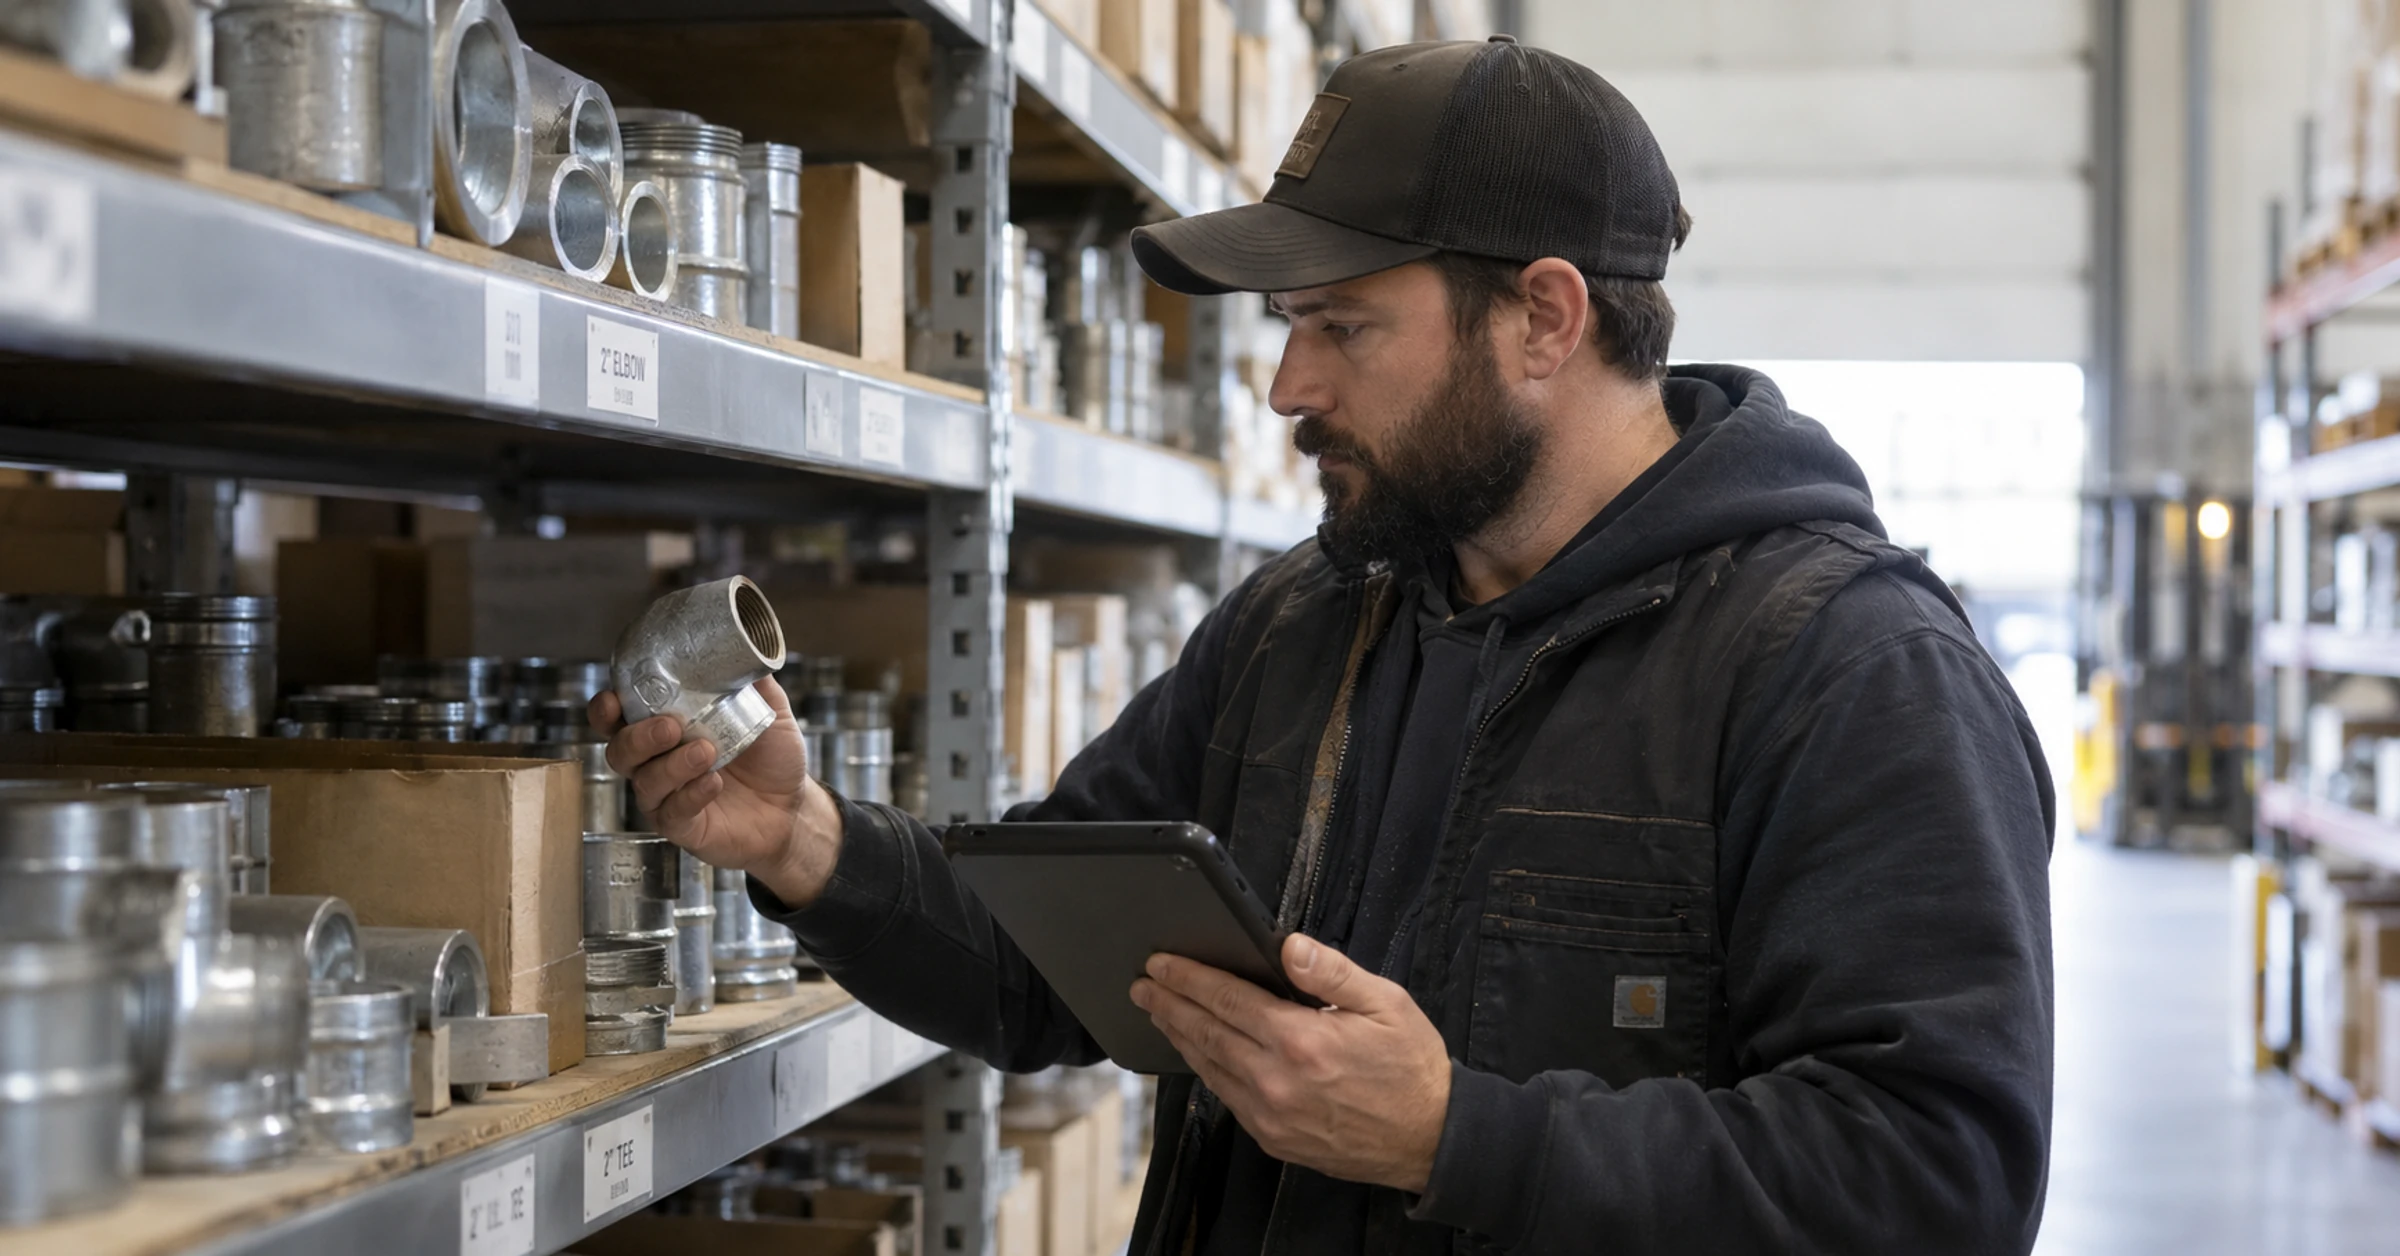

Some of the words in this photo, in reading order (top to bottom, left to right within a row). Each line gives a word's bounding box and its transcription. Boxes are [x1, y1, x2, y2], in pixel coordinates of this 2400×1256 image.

[600, 347, 611, 374] 2"
[613, 350, 646, 382] ELBOW
[603, 1148, 613, 1177] 2"
[616, 1139, 634, 1170] TEE
